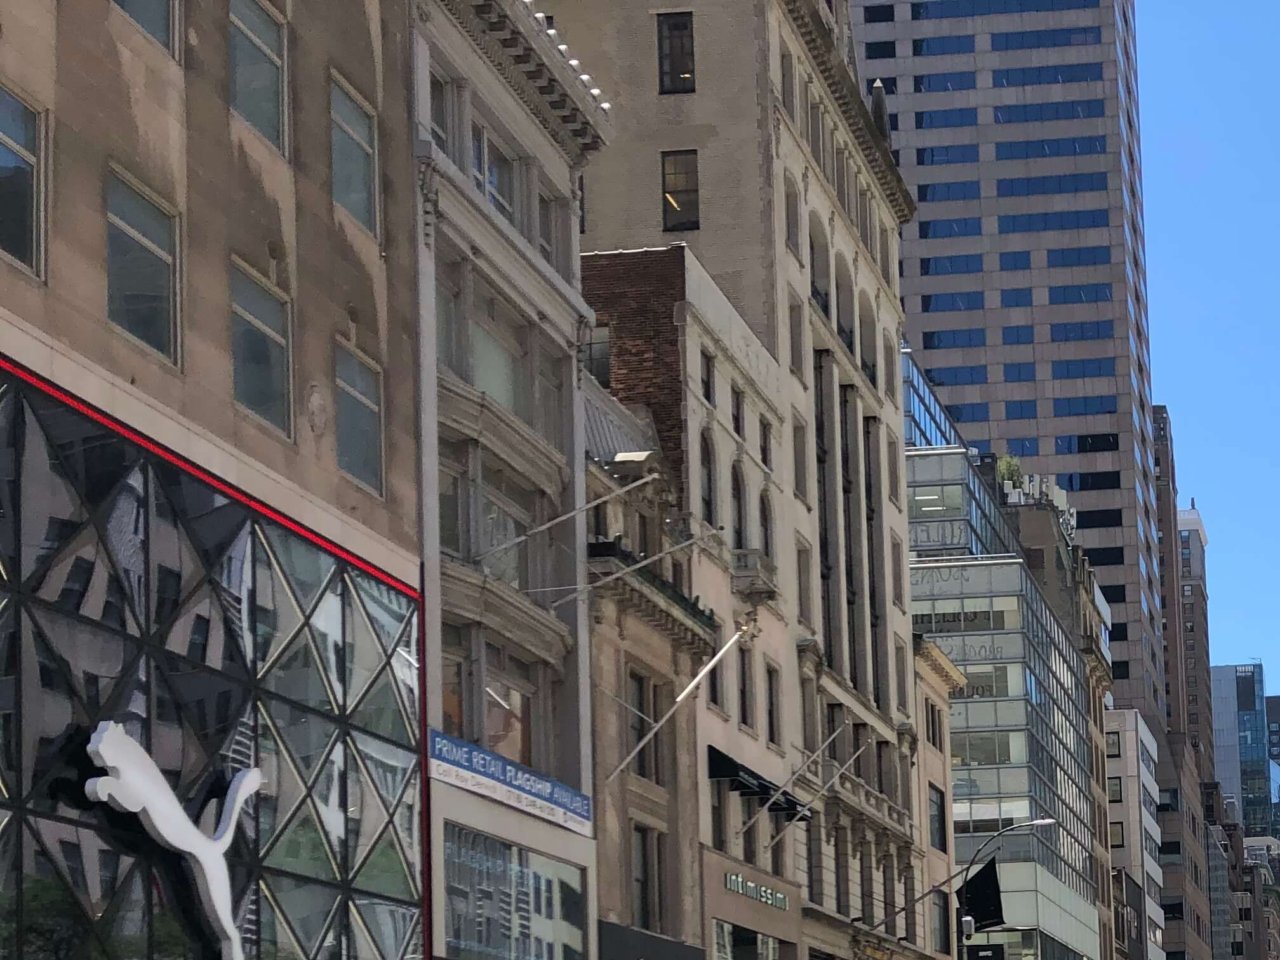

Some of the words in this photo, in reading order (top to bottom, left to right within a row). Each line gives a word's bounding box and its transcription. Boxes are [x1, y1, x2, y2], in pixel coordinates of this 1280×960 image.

[435, 737, 469, 766] PRIME
[472, 751, 505, 779] RETAIL
[506, 765, 552, 799] FLAGSHIP
